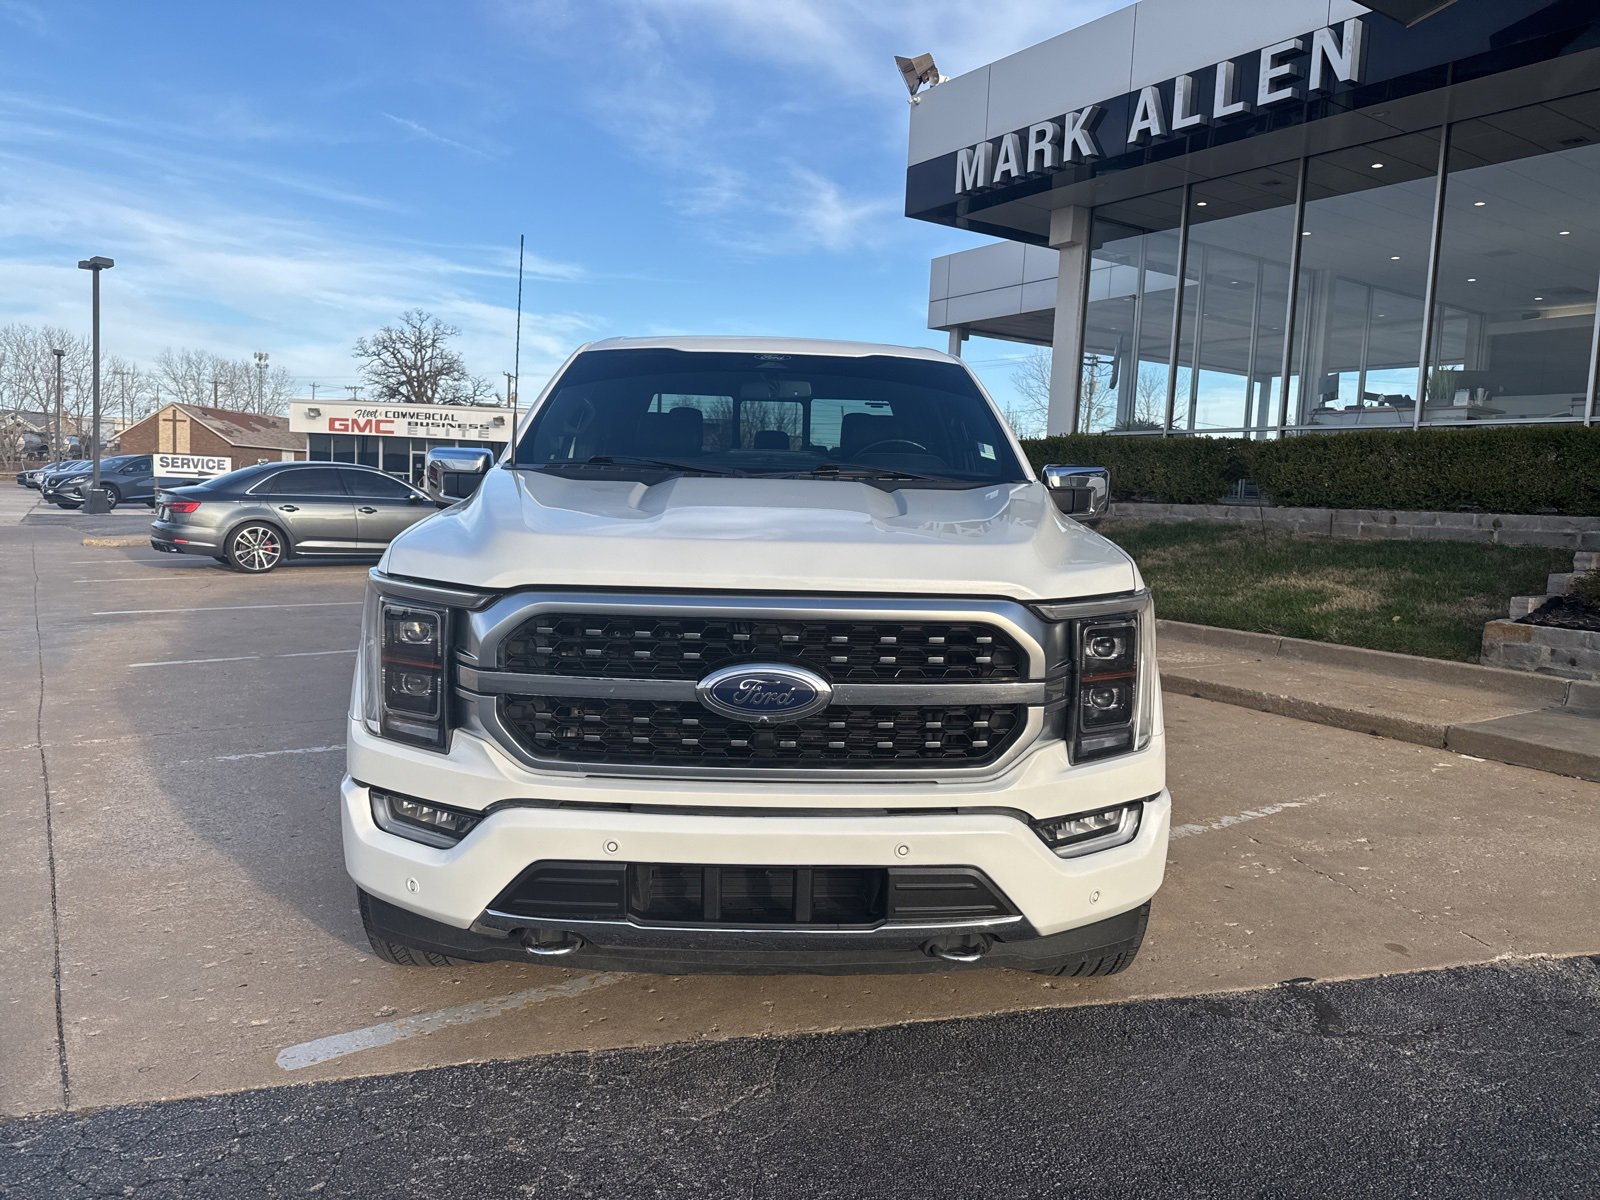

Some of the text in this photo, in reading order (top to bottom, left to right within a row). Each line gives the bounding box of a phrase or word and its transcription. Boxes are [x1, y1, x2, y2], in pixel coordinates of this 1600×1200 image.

[955, 17, 1364, 195] MARK ALLEN
[354, 408, 379, 419] Fleet
[384, 410, 459, 422] COMMERCIAL
[328, 417, 395, 435] GMC
[408, 421, 490, 430] BUSINESS
[408, 427, 490, 439] ELITE
[159, 456, 226, 471] SERVICE
[733, 678, 796, 706] Ford
